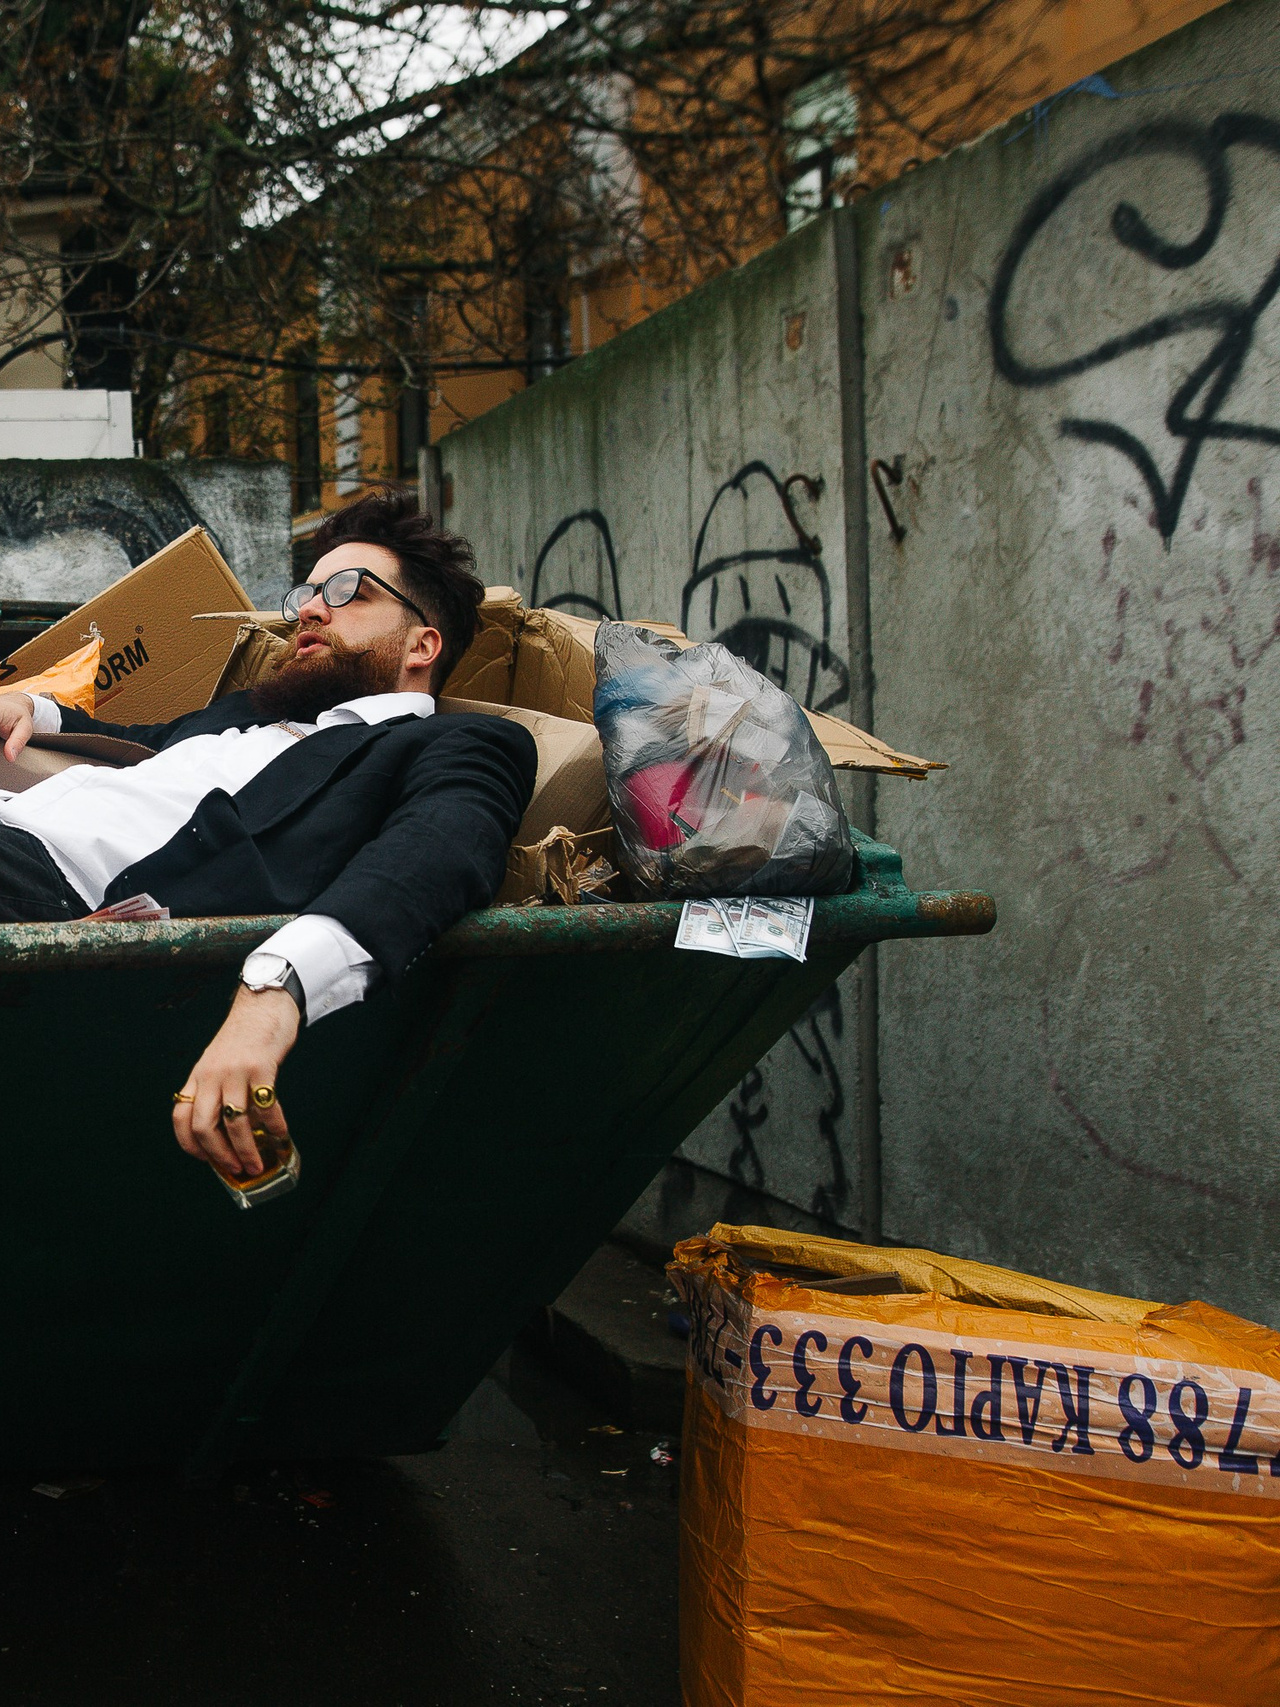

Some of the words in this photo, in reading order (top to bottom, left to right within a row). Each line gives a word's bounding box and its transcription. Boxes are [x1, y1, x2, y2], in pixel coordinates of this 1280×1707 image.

[94, 637, 150, 691] ORM
[888, 1342, 1095, 1455] КАРГО
[1117, 1372, 1280, 1478] 788
